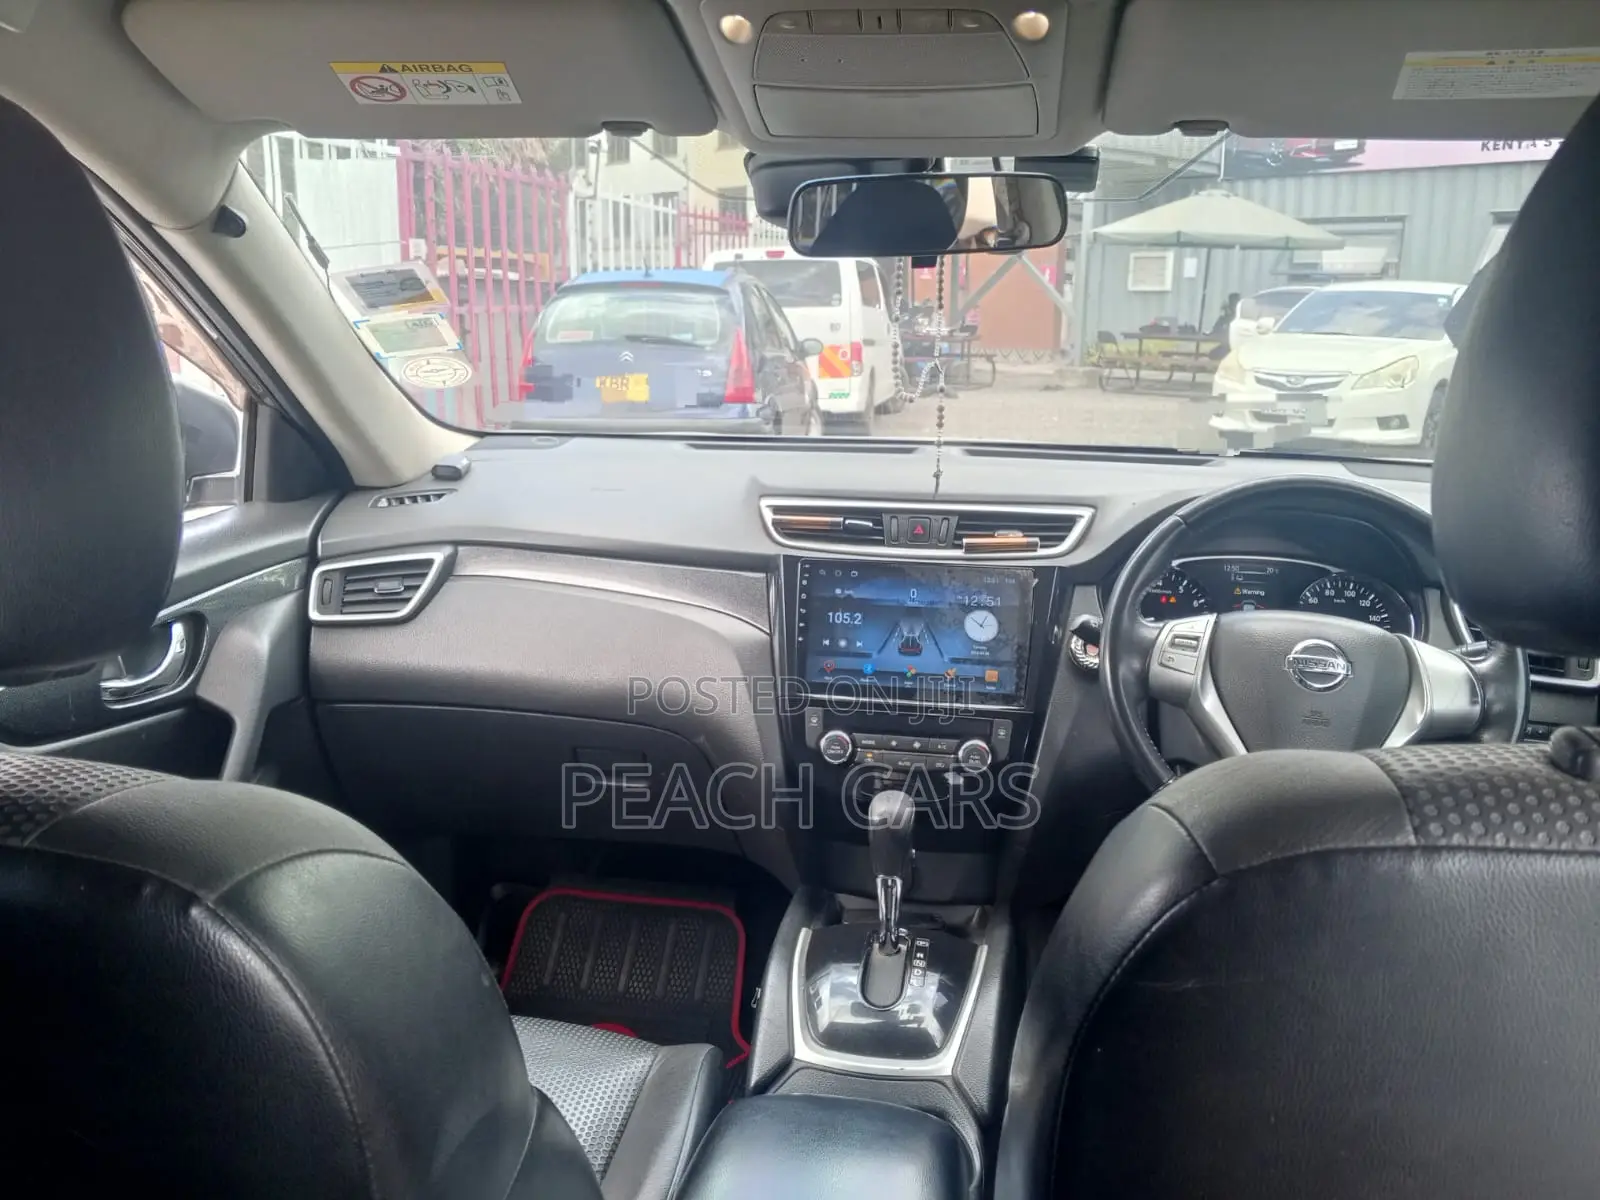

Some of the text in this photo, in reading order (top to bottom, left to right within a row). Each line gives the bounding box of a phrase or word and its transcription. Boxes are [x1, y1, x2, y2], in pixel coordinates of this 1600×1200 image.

[401, 64, 473, 73] AIRBAG
[910, 588, 918, 598] 0
[1178, 585, 1184, 593] 5
[1242, 588, 1265, 598] Warning
[964, 595, 1001, 607] 12:51
[1193, 599, 1199, 607] 6
[1359, 599, 1371, 607] 120
[827, 611, 862, 625] 105.2
[1293, 657, 1346, 671] NISSAN
